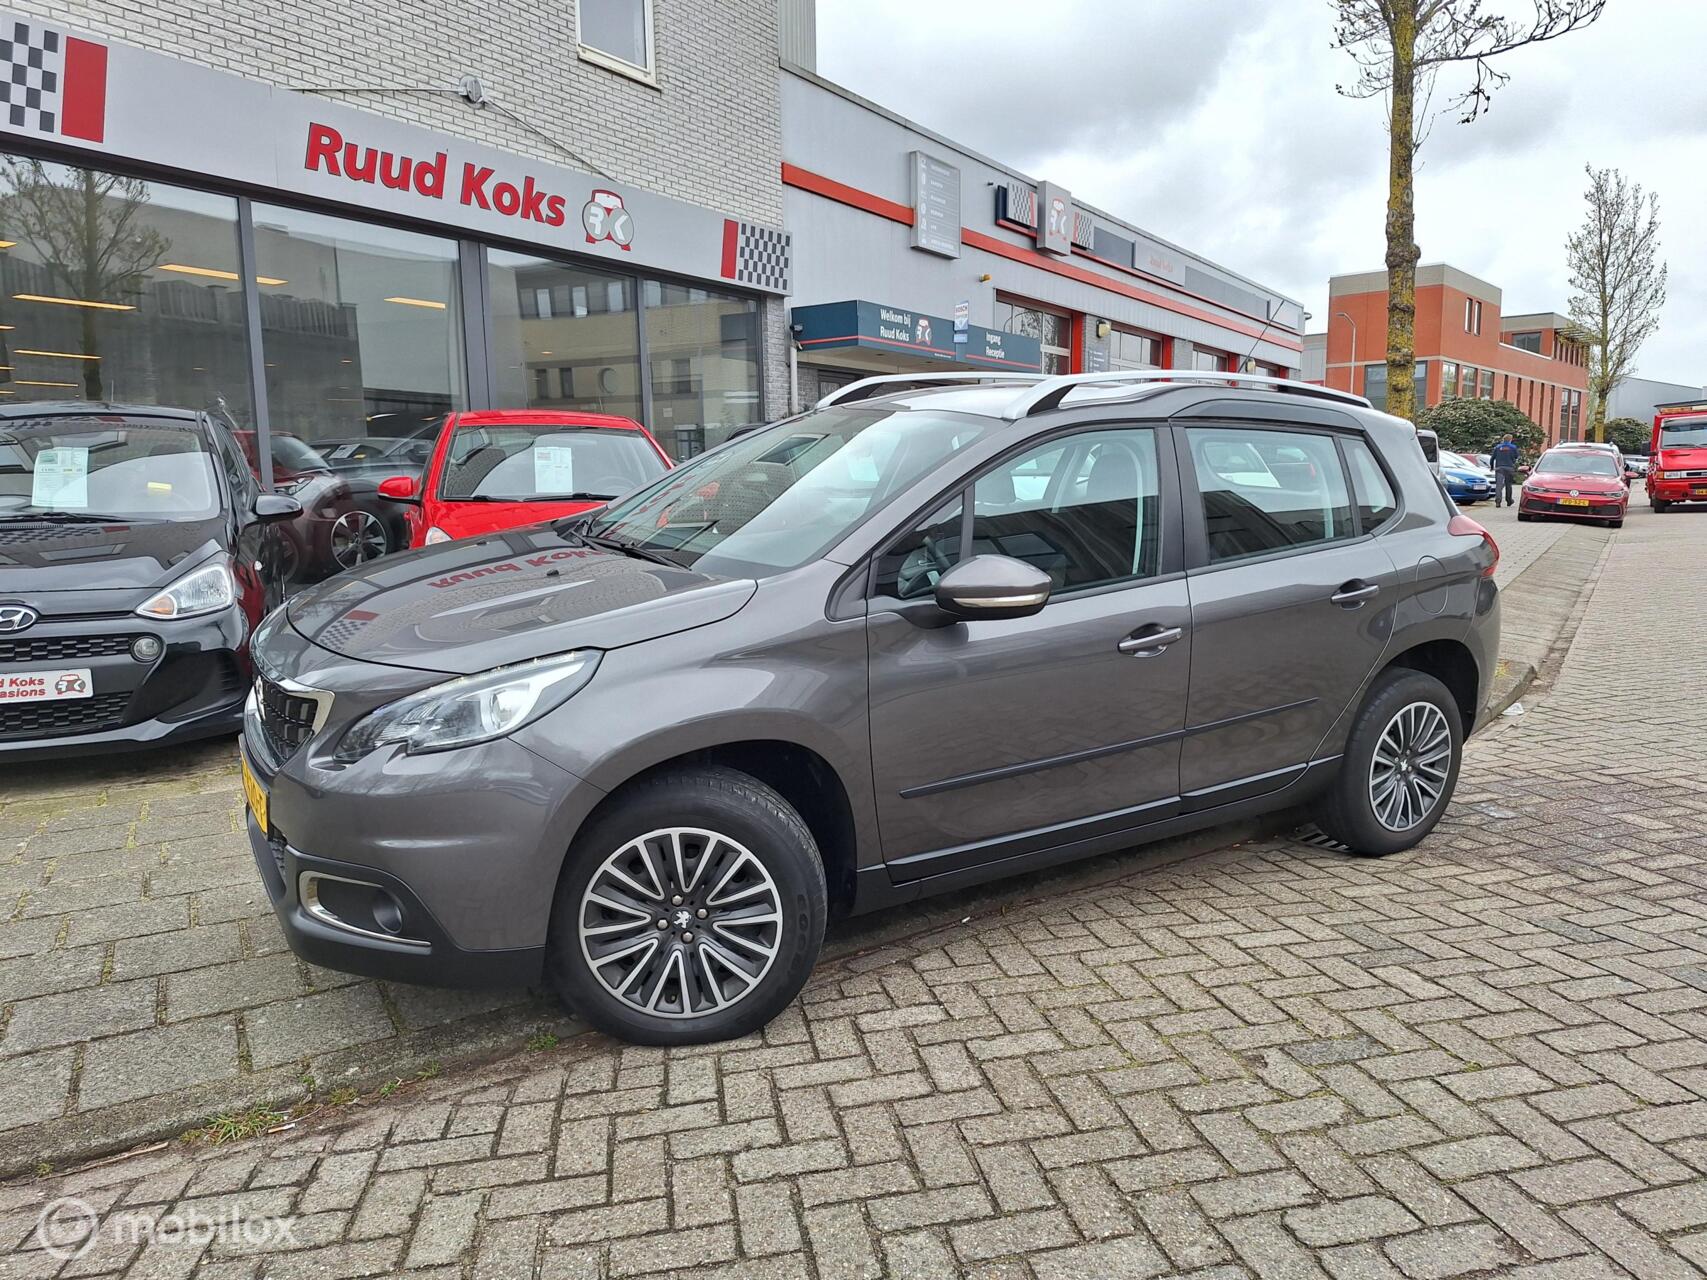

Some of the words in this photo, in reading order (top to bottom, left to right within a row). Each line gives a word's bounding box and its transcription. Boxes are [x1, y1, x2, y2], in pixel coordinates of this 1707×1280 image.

[304, 122, 447, 200] Ruud
[459, 162, 566, 227] Koks
[880, 308, 903, 325] Welkom
[903, 313, 911, 328] bij
[880, 326, 895, 339] Ruud
[895, 328, 910, 342] Koks
[986, 331, 1001, 346] Ingang
[9, 677, 45, 687] Koks
[0, 688, 46, 698] asions
